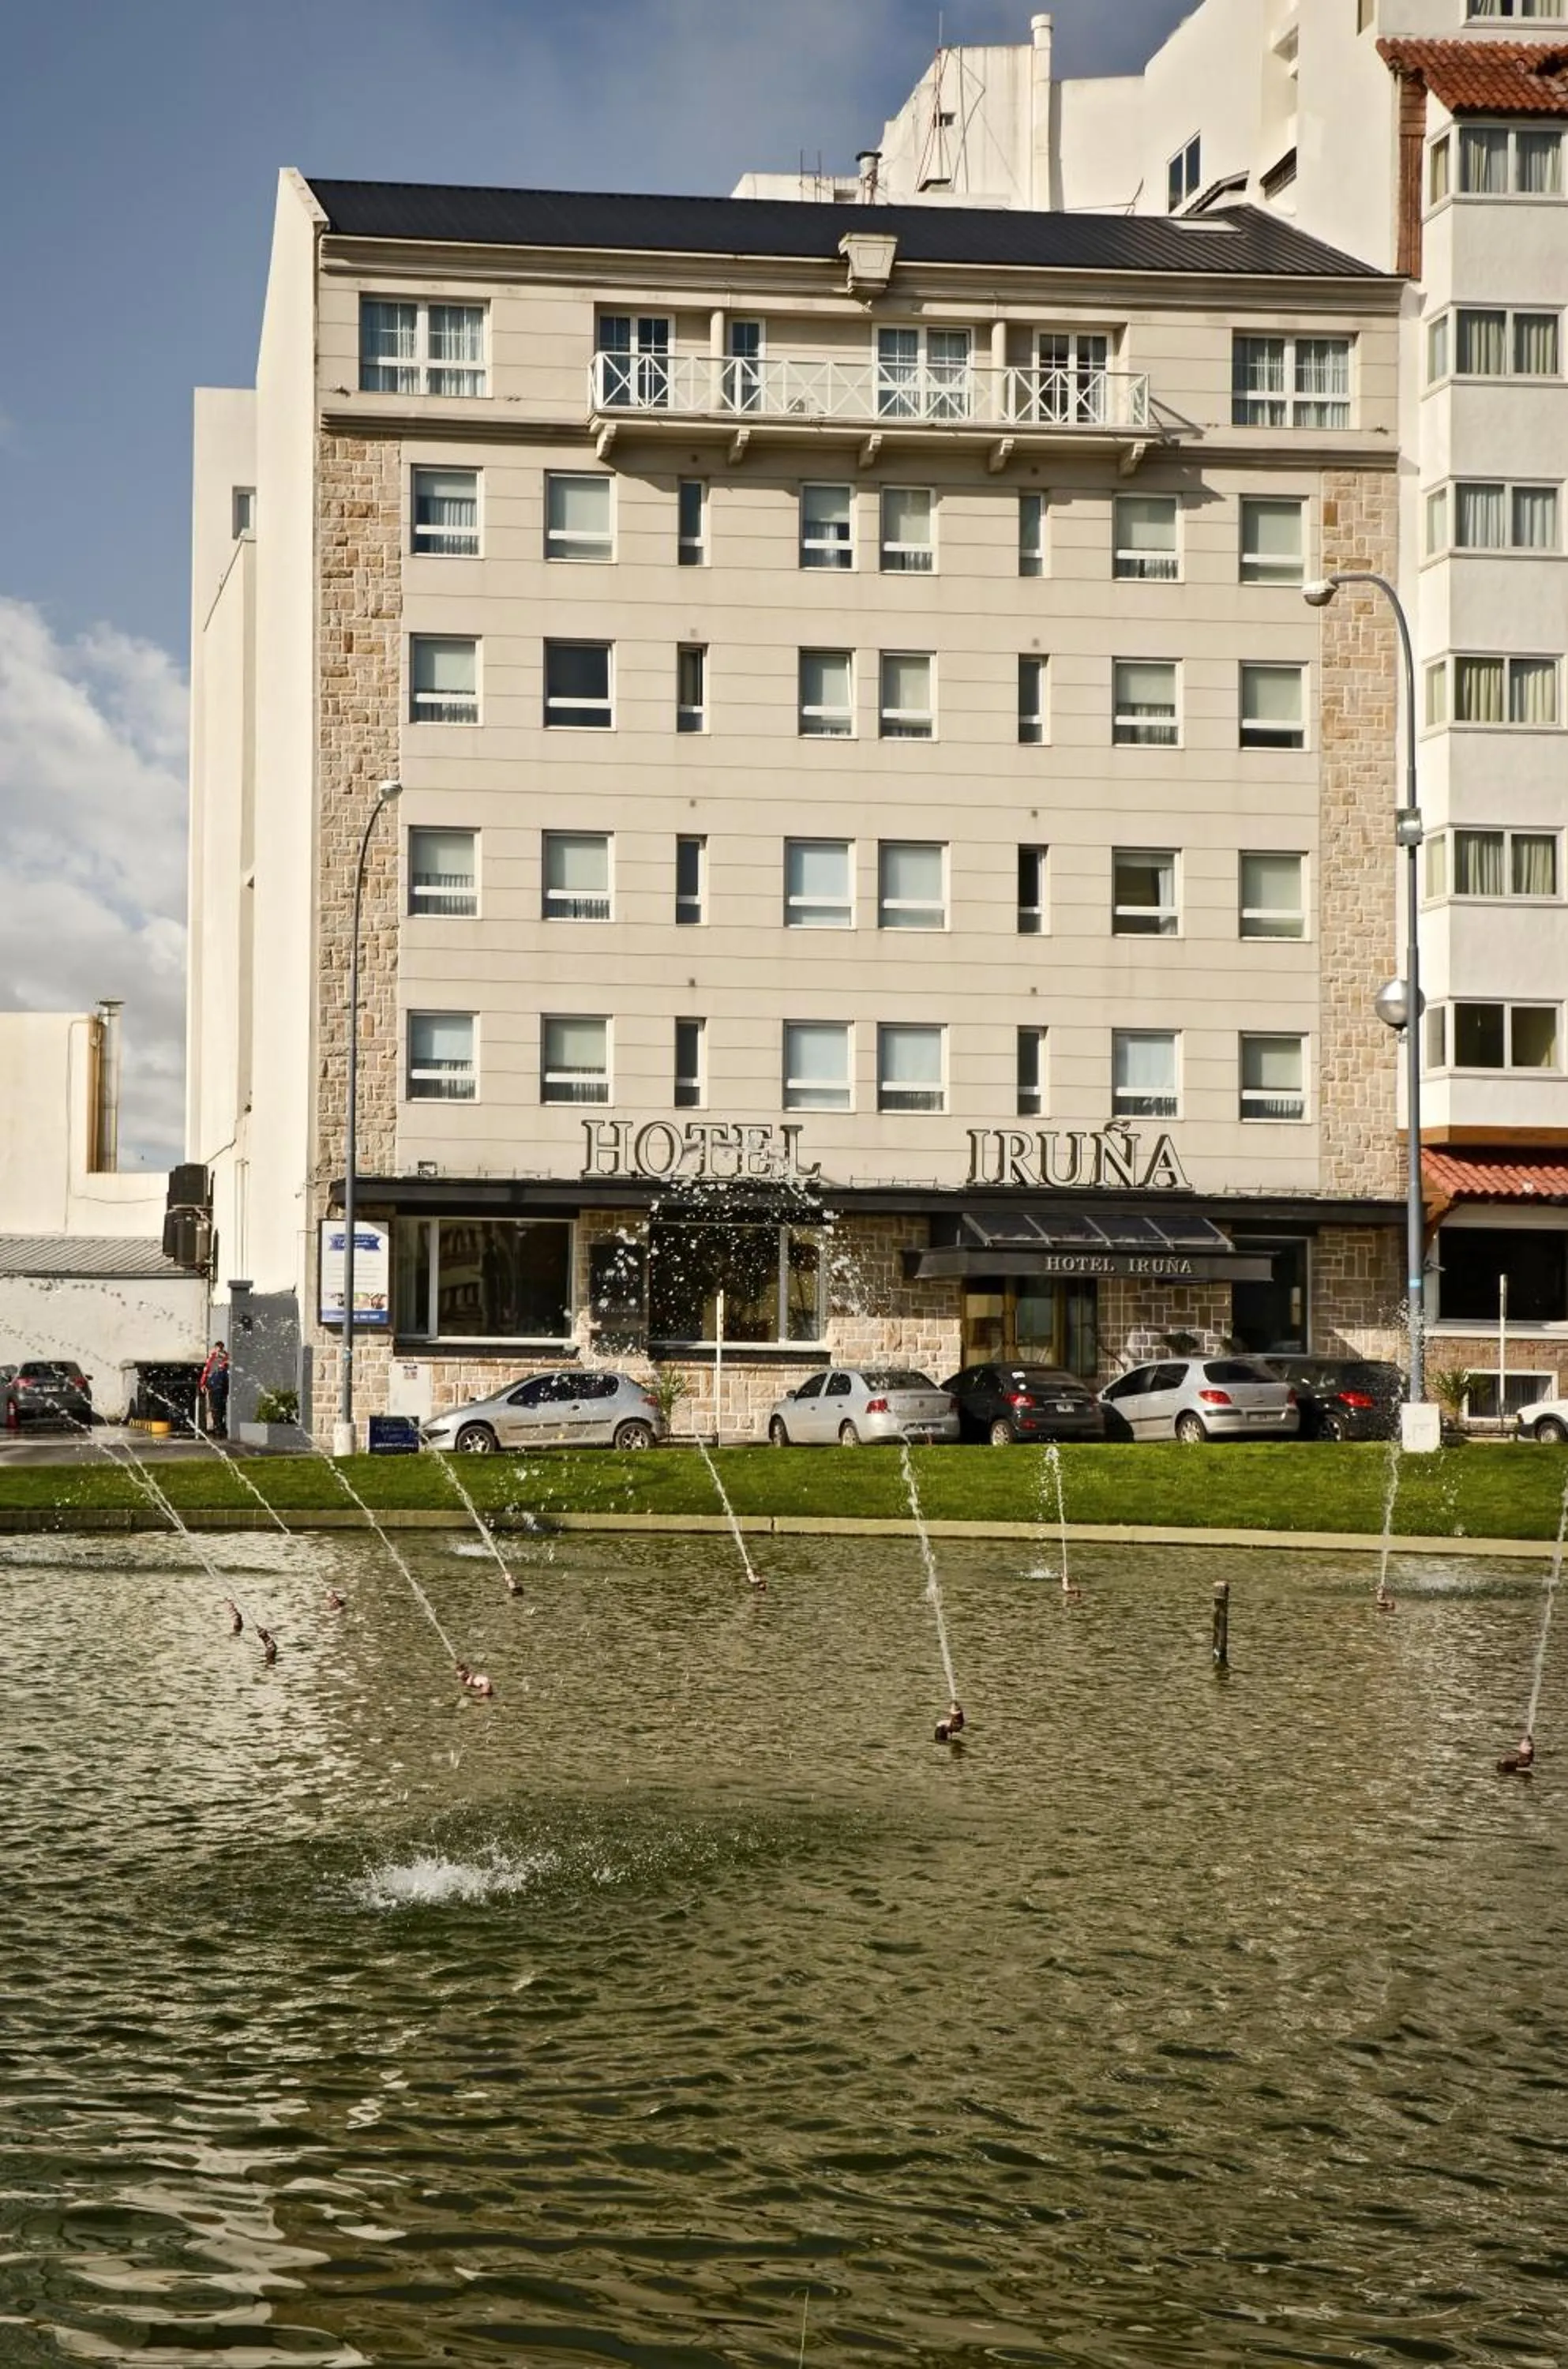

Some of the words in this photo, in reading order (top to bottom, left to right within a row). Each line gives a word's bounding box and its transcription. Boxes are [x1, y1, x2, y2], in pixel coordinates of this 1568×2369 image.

[581, 1119, 821, 1180] HOTEL
[966, 1120, 1193, 1188] IRUÑA
[1045, 1256, 1115, 1272] HOTEL
[1128, 1256, 1192, 1274] IRUÑA
